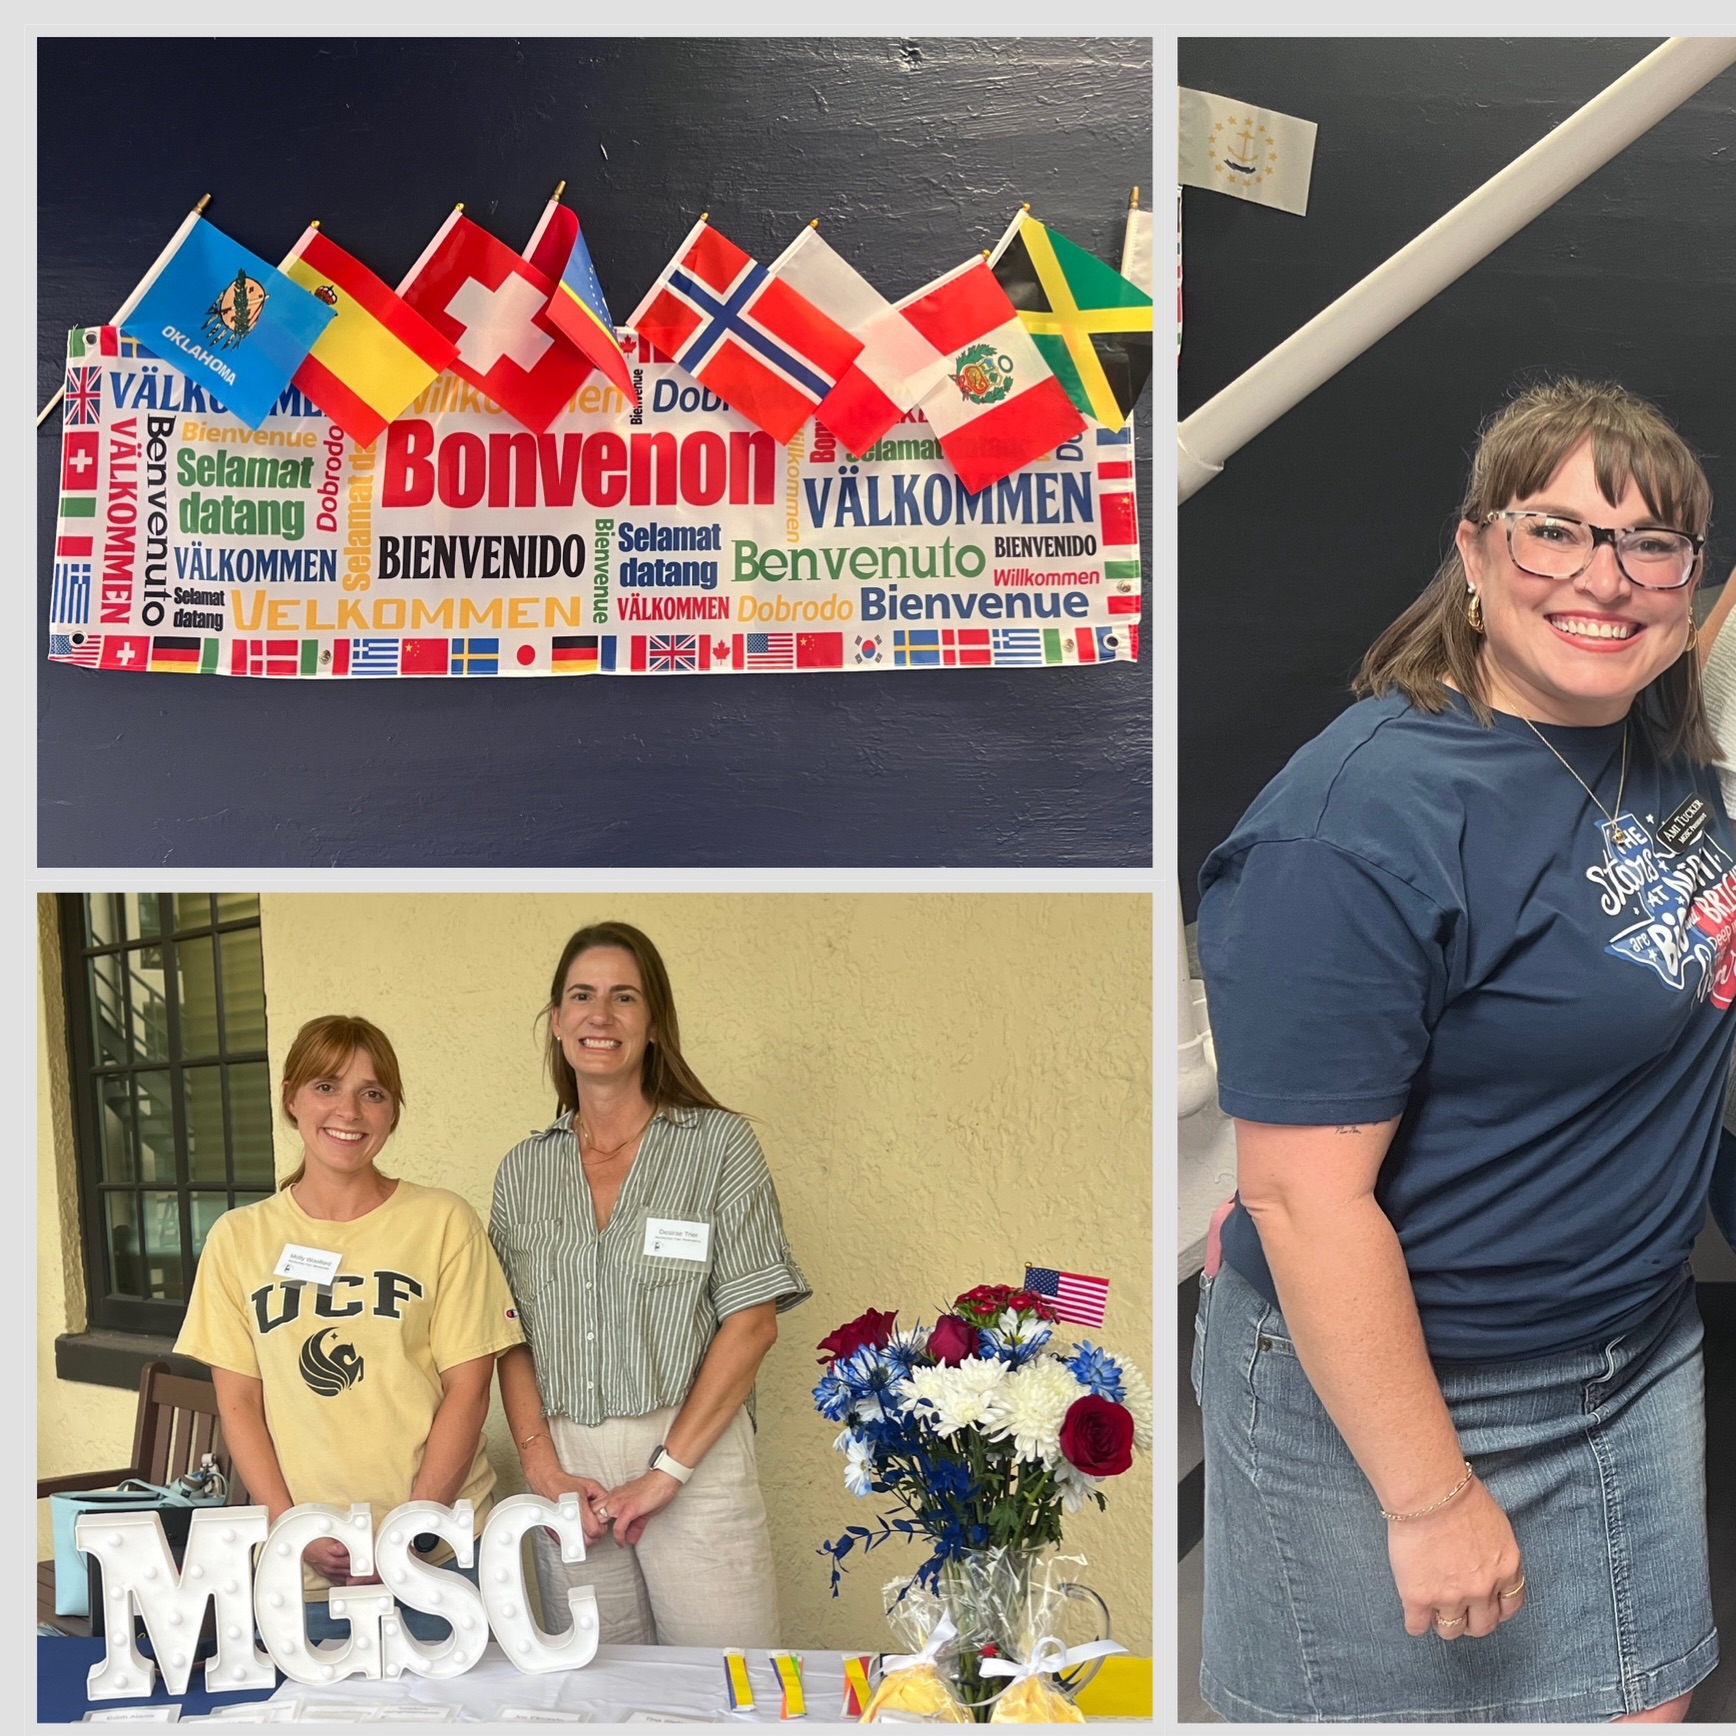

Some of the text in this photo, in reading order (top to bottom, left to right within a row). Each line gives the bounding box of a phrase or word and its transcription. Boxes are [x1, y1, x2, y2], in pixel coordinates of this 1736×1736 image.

[161, 325, 237, 387] OKLAHOMA
[181, 421, 317, 448] Bienvenue
[176, 447, 314, 489] Selamat
[316, 425, 345, 532] Dobrodo
[381, 419, 775, 510] Bonvenon
[178, 491, 305, 540] datang
[803, 465, 1094, 529] VÄLKOMMEN
[100, 417, 138, 626] VÄLKOMMEN
[141, 414, 177, 627] Benvenuto
[342, 474, 374, 592] Selamat
[617, 522, 722, 553] Selamat
[173, 541, 338, 583] VÄLKOMMEN
[377, 533, 586, 580] BIENVENIDO
[730, 535, 986, 583] Benvenuto
[994, 534, 1098, 559] BIENVENIDO
[593, 519, 614, 624] Bienvenue
[619, 557, 718, 590] datang
[993, 567, 1100, 588] Willkommen
[173, 587, 225, 607] Selamat
[231, 589, 582, 631] VELKOMMEN
[617, 591, 730, 622] VÄLKOMMEN
[736, 594, 854, 623] Dobrodo
[860, 584, 1089, 622] Bienvenue
[173, 607, 224, 631] datang
[1663, 824, 1681, 842] AMI
[1647, 885, 1670, 907] AT
[1629, 932, 1650, 953] are
[251, 1270, 423, 1334] UCF
[75, 1492, 600, 1701] MGSC
